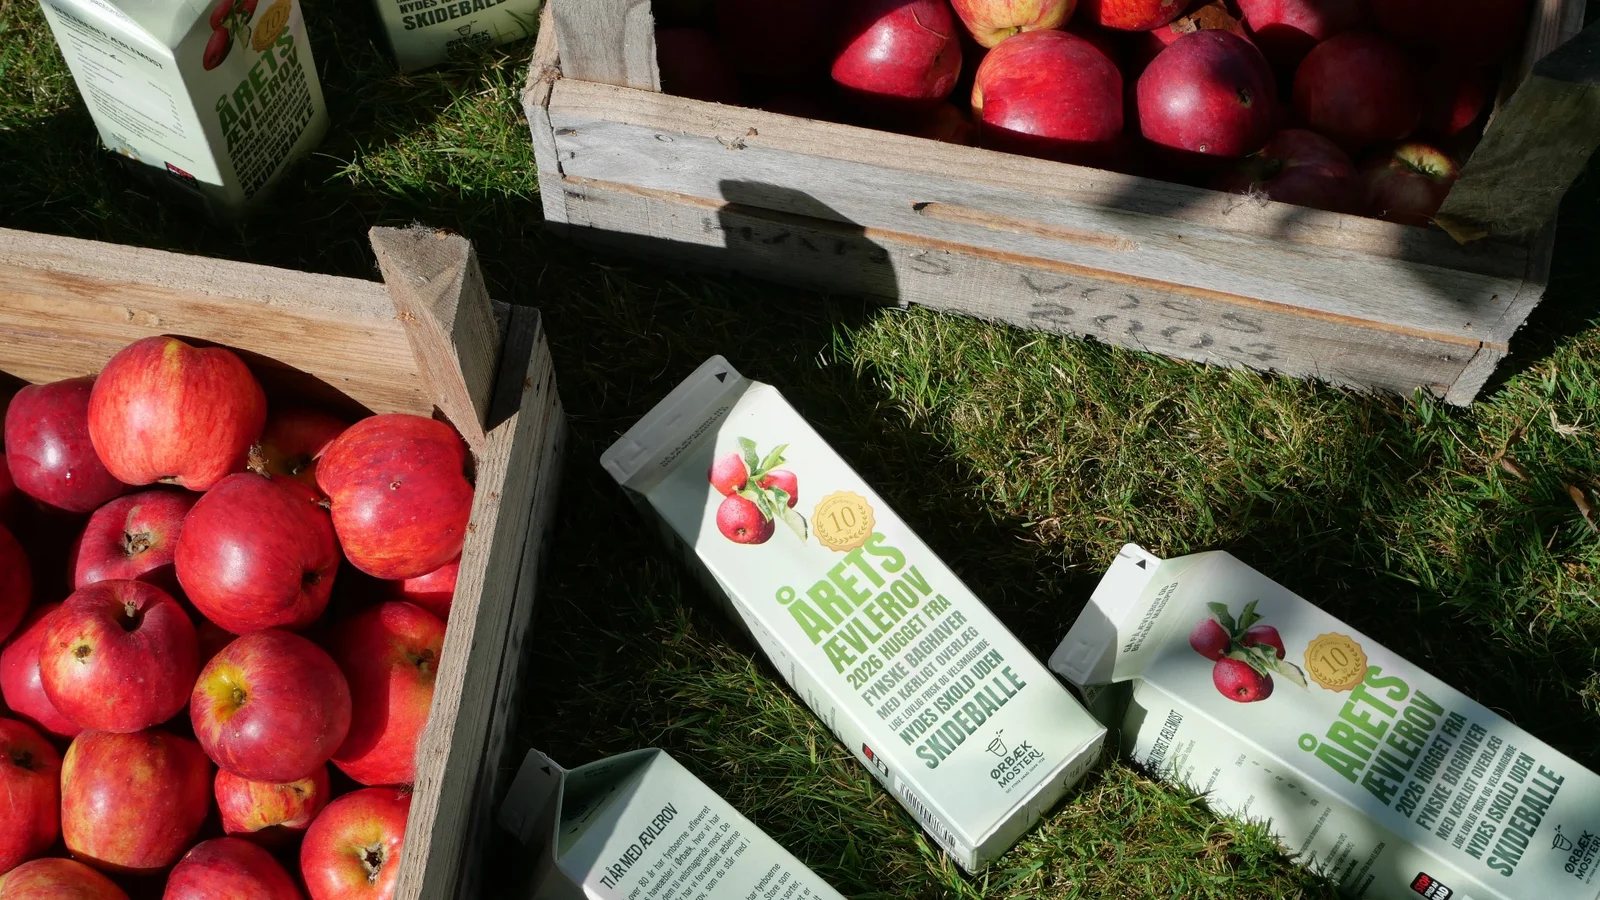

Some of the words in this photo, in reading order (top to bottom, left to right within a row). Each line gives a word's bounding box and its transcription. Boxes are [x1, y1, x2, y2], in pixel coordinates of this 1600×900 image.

[400, 0, 438, 14] NYDES
[402, 0, 507, 31] SKIDEBALL
[215, 26, 294, 138] ÅRETS
[228, 46, 298, 154] ÆVLEROV
[230, 128, 255, 162] 2026
[256, 86, 287, 131] HUGGET
[234, 128, 266, 172] FYNSKE
[244, 103, 315, 201] SKIDEBALLE
[828, 508, 856, 533] 10
[776, 531, 909, 646] ÅRETS
[822, 565, 933, 675] ÆVLEROV
[846, 653, 884, 691] 2026
[878, 614, 928, 661] HUGGET
[922, 593, 952, 622] FRA
[861, 661, 910, 707] FYNSKE
[904, 609, 968, 669] BAGHAVER
[876, 696, 902, 721] MED
[897, 662, 939, 701] KÆRLIGT
[935, 625, 980, 667] OVERLÆG
[1320, 648, 1348, 674] 10
[888, 715, 905, 732] LIGE
[901, 697, 925, 720] LOVLIG
[921, 682, 941, 702] FRISK
[938, 674, 950, 686] OG
[946, 638, 990, 678] VELSMAGENDE
[899, 707, 939, 746] NYDES
[933, 673, 977, 715] ISKOLD
[970, 648, 1004, 681] UDEN
[915, 665, 1027, 770] SKIDEBALLE
[1298, 666, 1408, 784] ÅRETS
[990, 740, 1032, 780] ØRBÆK
[998, 749, 1043, 788] MOSTERI
[1361, 689, 1445, 806] ÆVLEROV
[1394, 780, 1427, 818] 2026
[1414, 734, 1453, 785] HUGGET
[1441, 711, 1468, 738] FRA
[1486, 744, 1517, 788] VELSMAGENDE
[1415, 783, 1453, 831] FYNSKE
[1441, 722, 1488, 787] BAGHAVER
[1435, 816, 1457, 841] MED
[1448, 776, 1480, 819] KÆRLIGT
[1470, 734, 1504, 780] OVERLÆG
[1481, 786, 1493, 798] OG
[638, 802, 678, 849] ÆVLEROV
[1459, 812, 1478, 836] LOVLIG
[1464, 819, 1498, 860] NYDES
[1485, 781, 1520, 824] ISKOLD
[1508, 752, 1536, 785] UDEN
[1471, 795, 1488, 815] FRISK
[1487, 765, 1565, 876] SKIDEBALLE
[619, 842, 644, 869] MED
[628, 886, 641, 900] over
[638, 876, 650, 888] 80
[647, 868, 656, 878] år
[653, 859, 666, 871] har
[663, 830, 690, 860] fynboerne
[686, 805, 711, 832] afleveret
[647, 869, 675, 898] haveæbler
[674, 845, 696, 866] Ørbæk,
[692, 831, 707, 846] hvor
[703, 823, 712, 832] vi
[709, 814, 720, 826] har
[662, 888, 676, 900] dem
[672, 879, 681, 889] til
[677, 846, 710, 883] velsmagende
[708, 831, 723, 849] most.
[720, 822, 730, 832] De
[682, 887, 694, 898] har
[691, 880, 699, 888] vi
[695, 853, 722, 882] forvandlet
[719, 831, 741, 855] æblerne
[1452, 833, 1466, 850] LIGE
[1565, 830, 1594, 873] ØRBÆK
[600, 875, 616, 889] TI
[606, 863, 627, 882] ÅR
[706, 878, 718, 892] som
[716, 869, 725, 879] du
[724, 856, 736, 870] står
[735, 842, 747, 857] med
[746, 891, 758, 900] har
[755, 864, 781, 892] fynboerne
[765, 884, 780, 900] Store
[778, 871, 791, 885] som
[784, 880, 802, 900] sorter,
[804, 887, 811, 896] er
[1414, 874, 1432, 893] STOP
[1432, 885, 1449, 899] MAD
